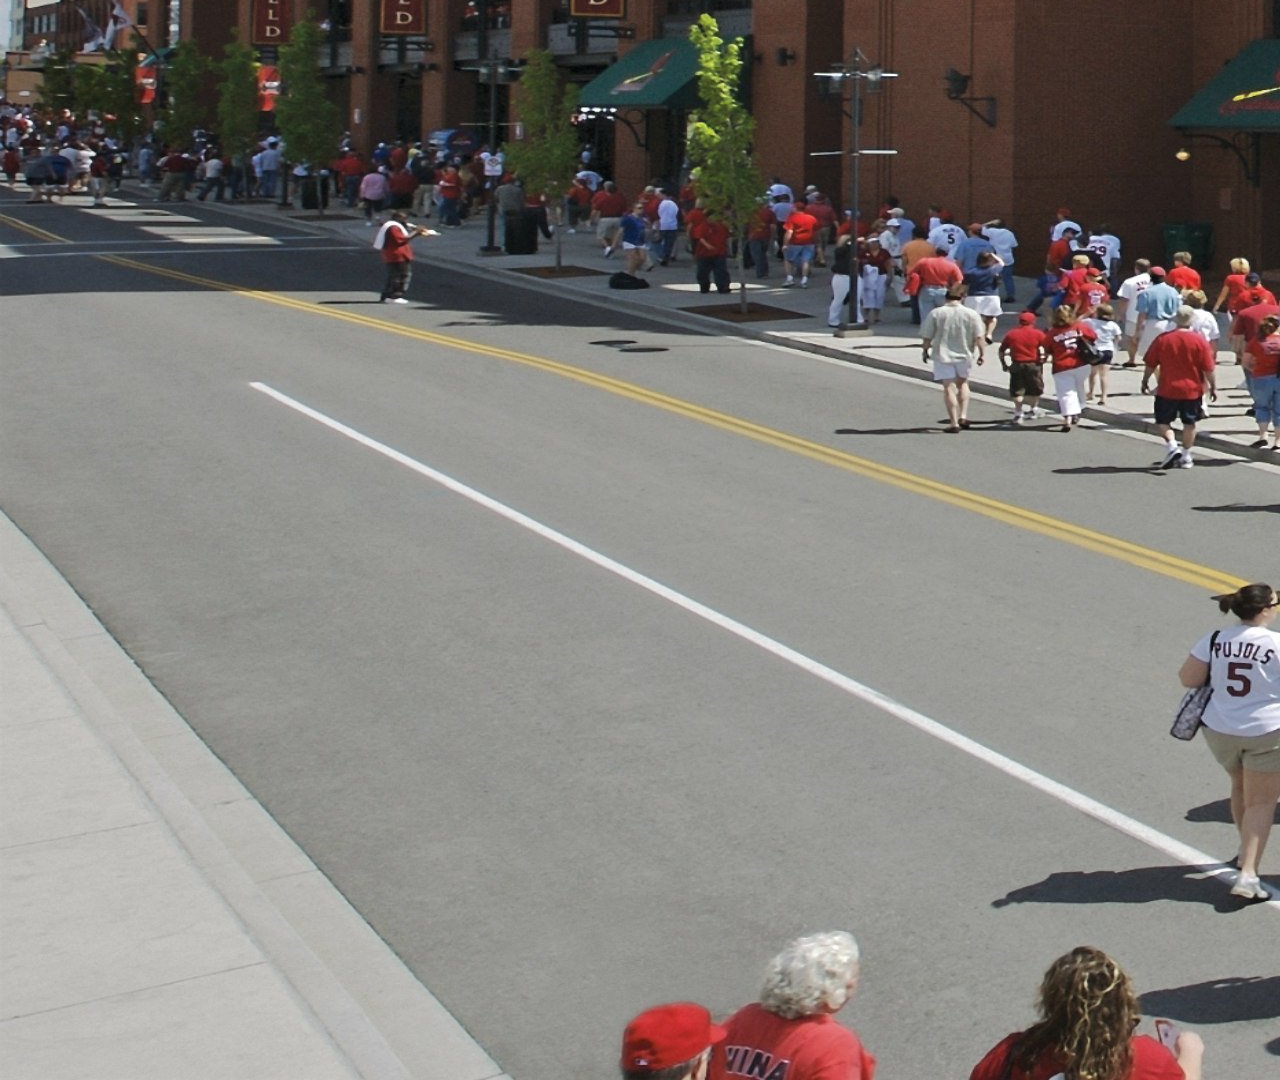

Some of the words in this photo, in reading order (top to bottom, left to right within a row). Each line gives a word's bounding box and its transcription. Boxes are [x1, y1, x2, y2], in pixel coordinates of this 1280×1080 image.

[947, 233, 956, 245] 5
[1063, 337, 1078, 350] 5
[1213, 641, 1275, 665] PUJOLS
[1226, 661, 1253, 698] 5
